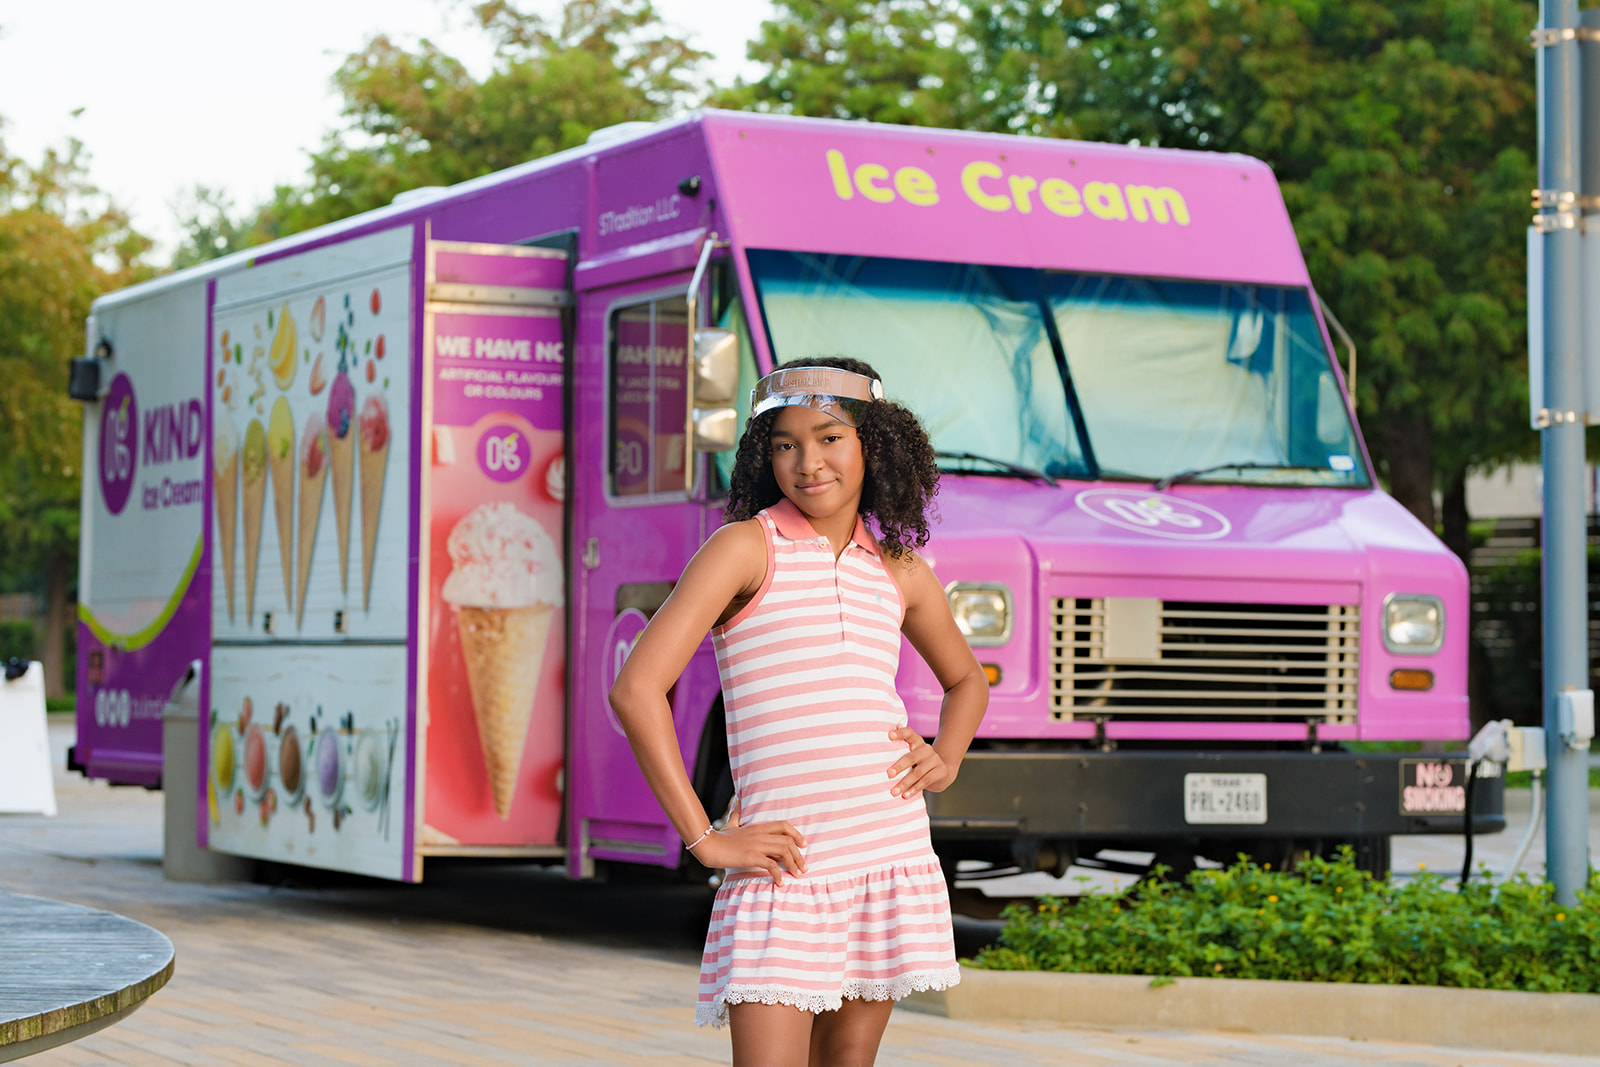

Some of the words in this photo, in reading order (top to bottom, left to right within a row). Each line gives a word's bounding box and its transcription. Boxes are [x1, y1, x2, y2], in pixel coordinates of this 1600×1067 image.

[826, 149, 940, 206] Ice
[961, 161, 1190, 226] Cream
[656, 194, 681, 222] LLC
[436, 335, 472, 358] WE
[475, 336, 532, 361] HAVE
[438, 367, 503, 384] ARTIFICIAL
[463, 383, 484, 398] OR
[485, 384, 544, 401] COLOURS
[143, 397, 203, 467] KIND
[141, 481, 159, 510] Ice
[161, 477, 204, 507] Cream
[1416, 761, 1453, 787] NO
